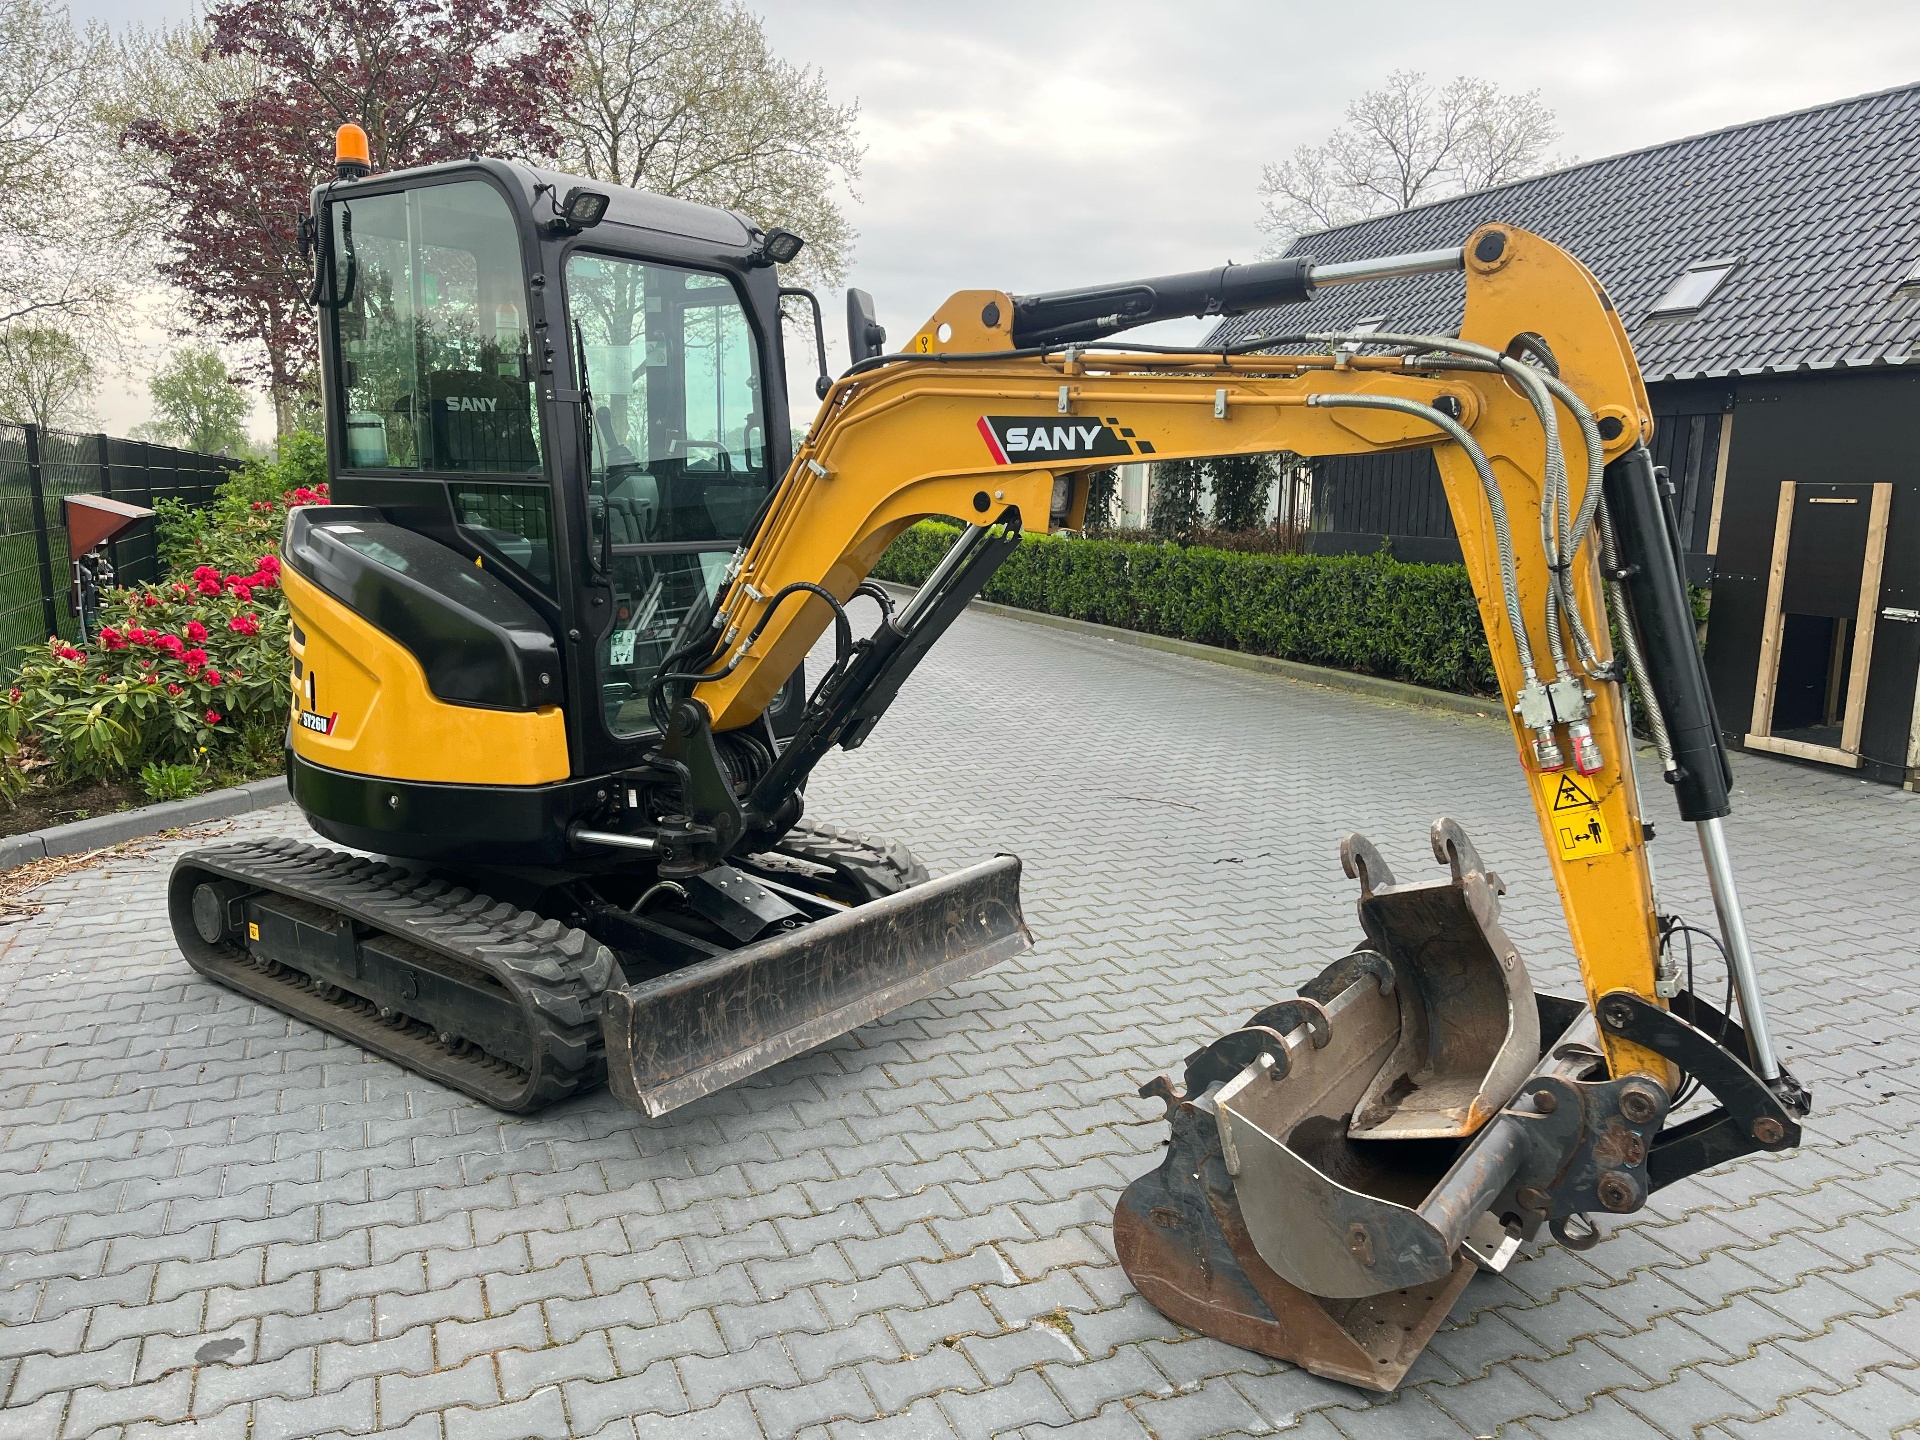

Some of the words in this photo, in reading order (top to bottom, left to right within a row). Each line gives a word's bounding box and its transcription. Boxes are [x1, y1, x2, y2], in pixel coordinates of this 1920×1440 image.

[445, 396, 498, 412] SANY
[1006, 425, 1102, 452] SANY
[303, 712, 327, 733] SY26U
